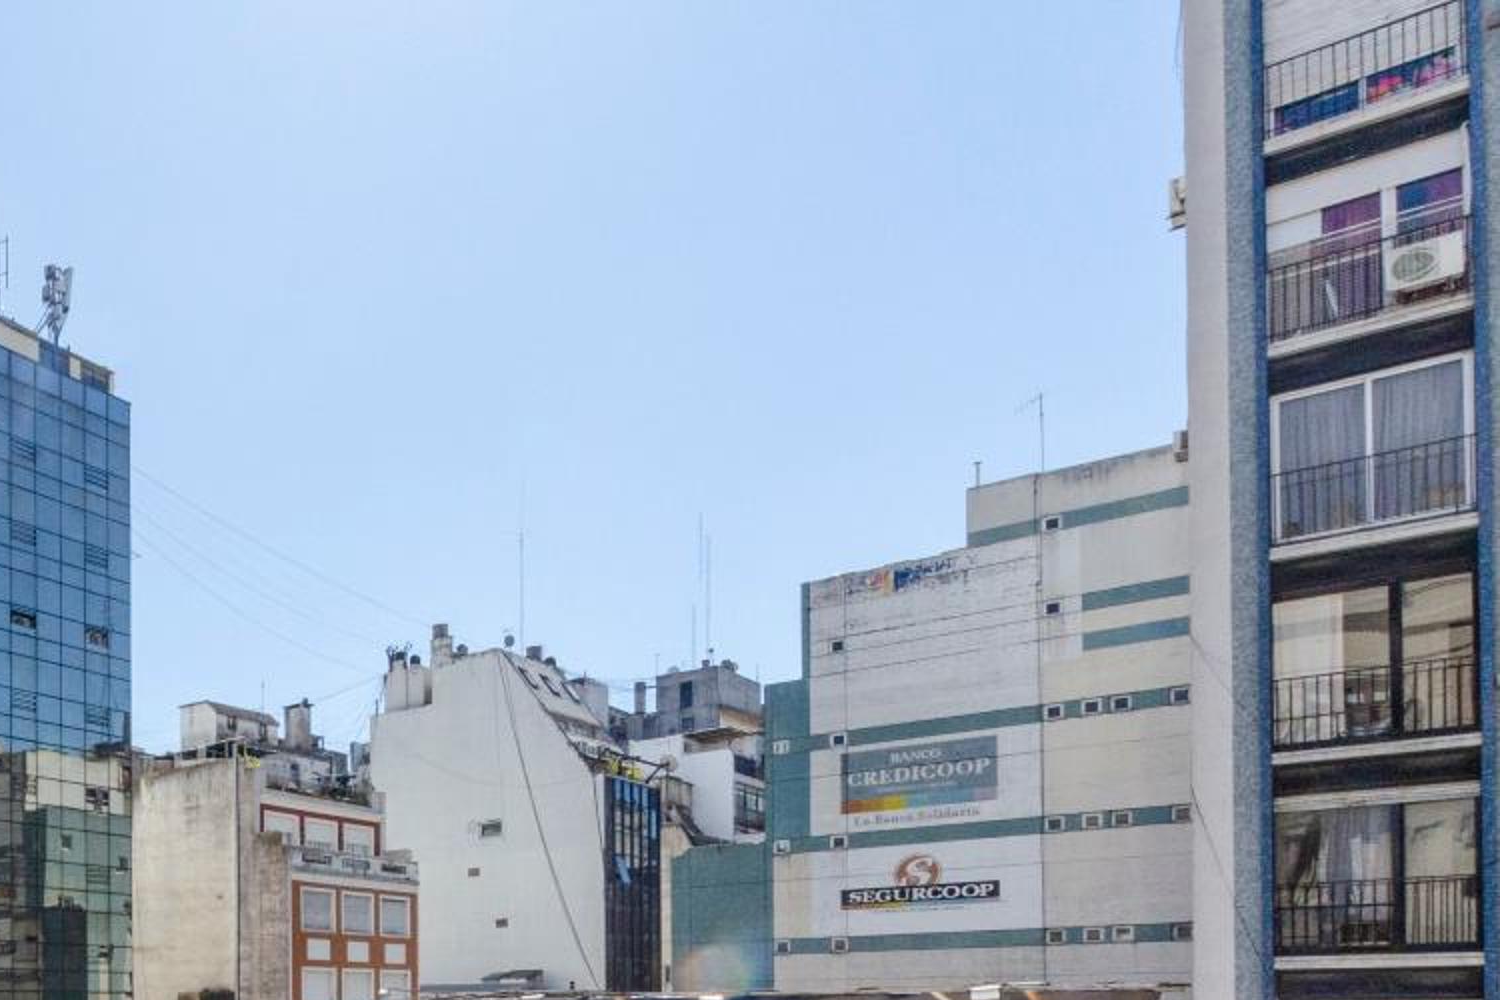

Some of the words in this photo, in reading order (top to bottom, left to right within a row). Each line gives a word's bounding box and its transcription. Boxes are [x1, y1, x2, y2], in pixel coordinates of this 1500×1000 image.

[891, 749, 942, 764] BANCO
[848, 757, 991, 786] CREDICOOP
[849, 882, 995, 904] SEGURCOOP
